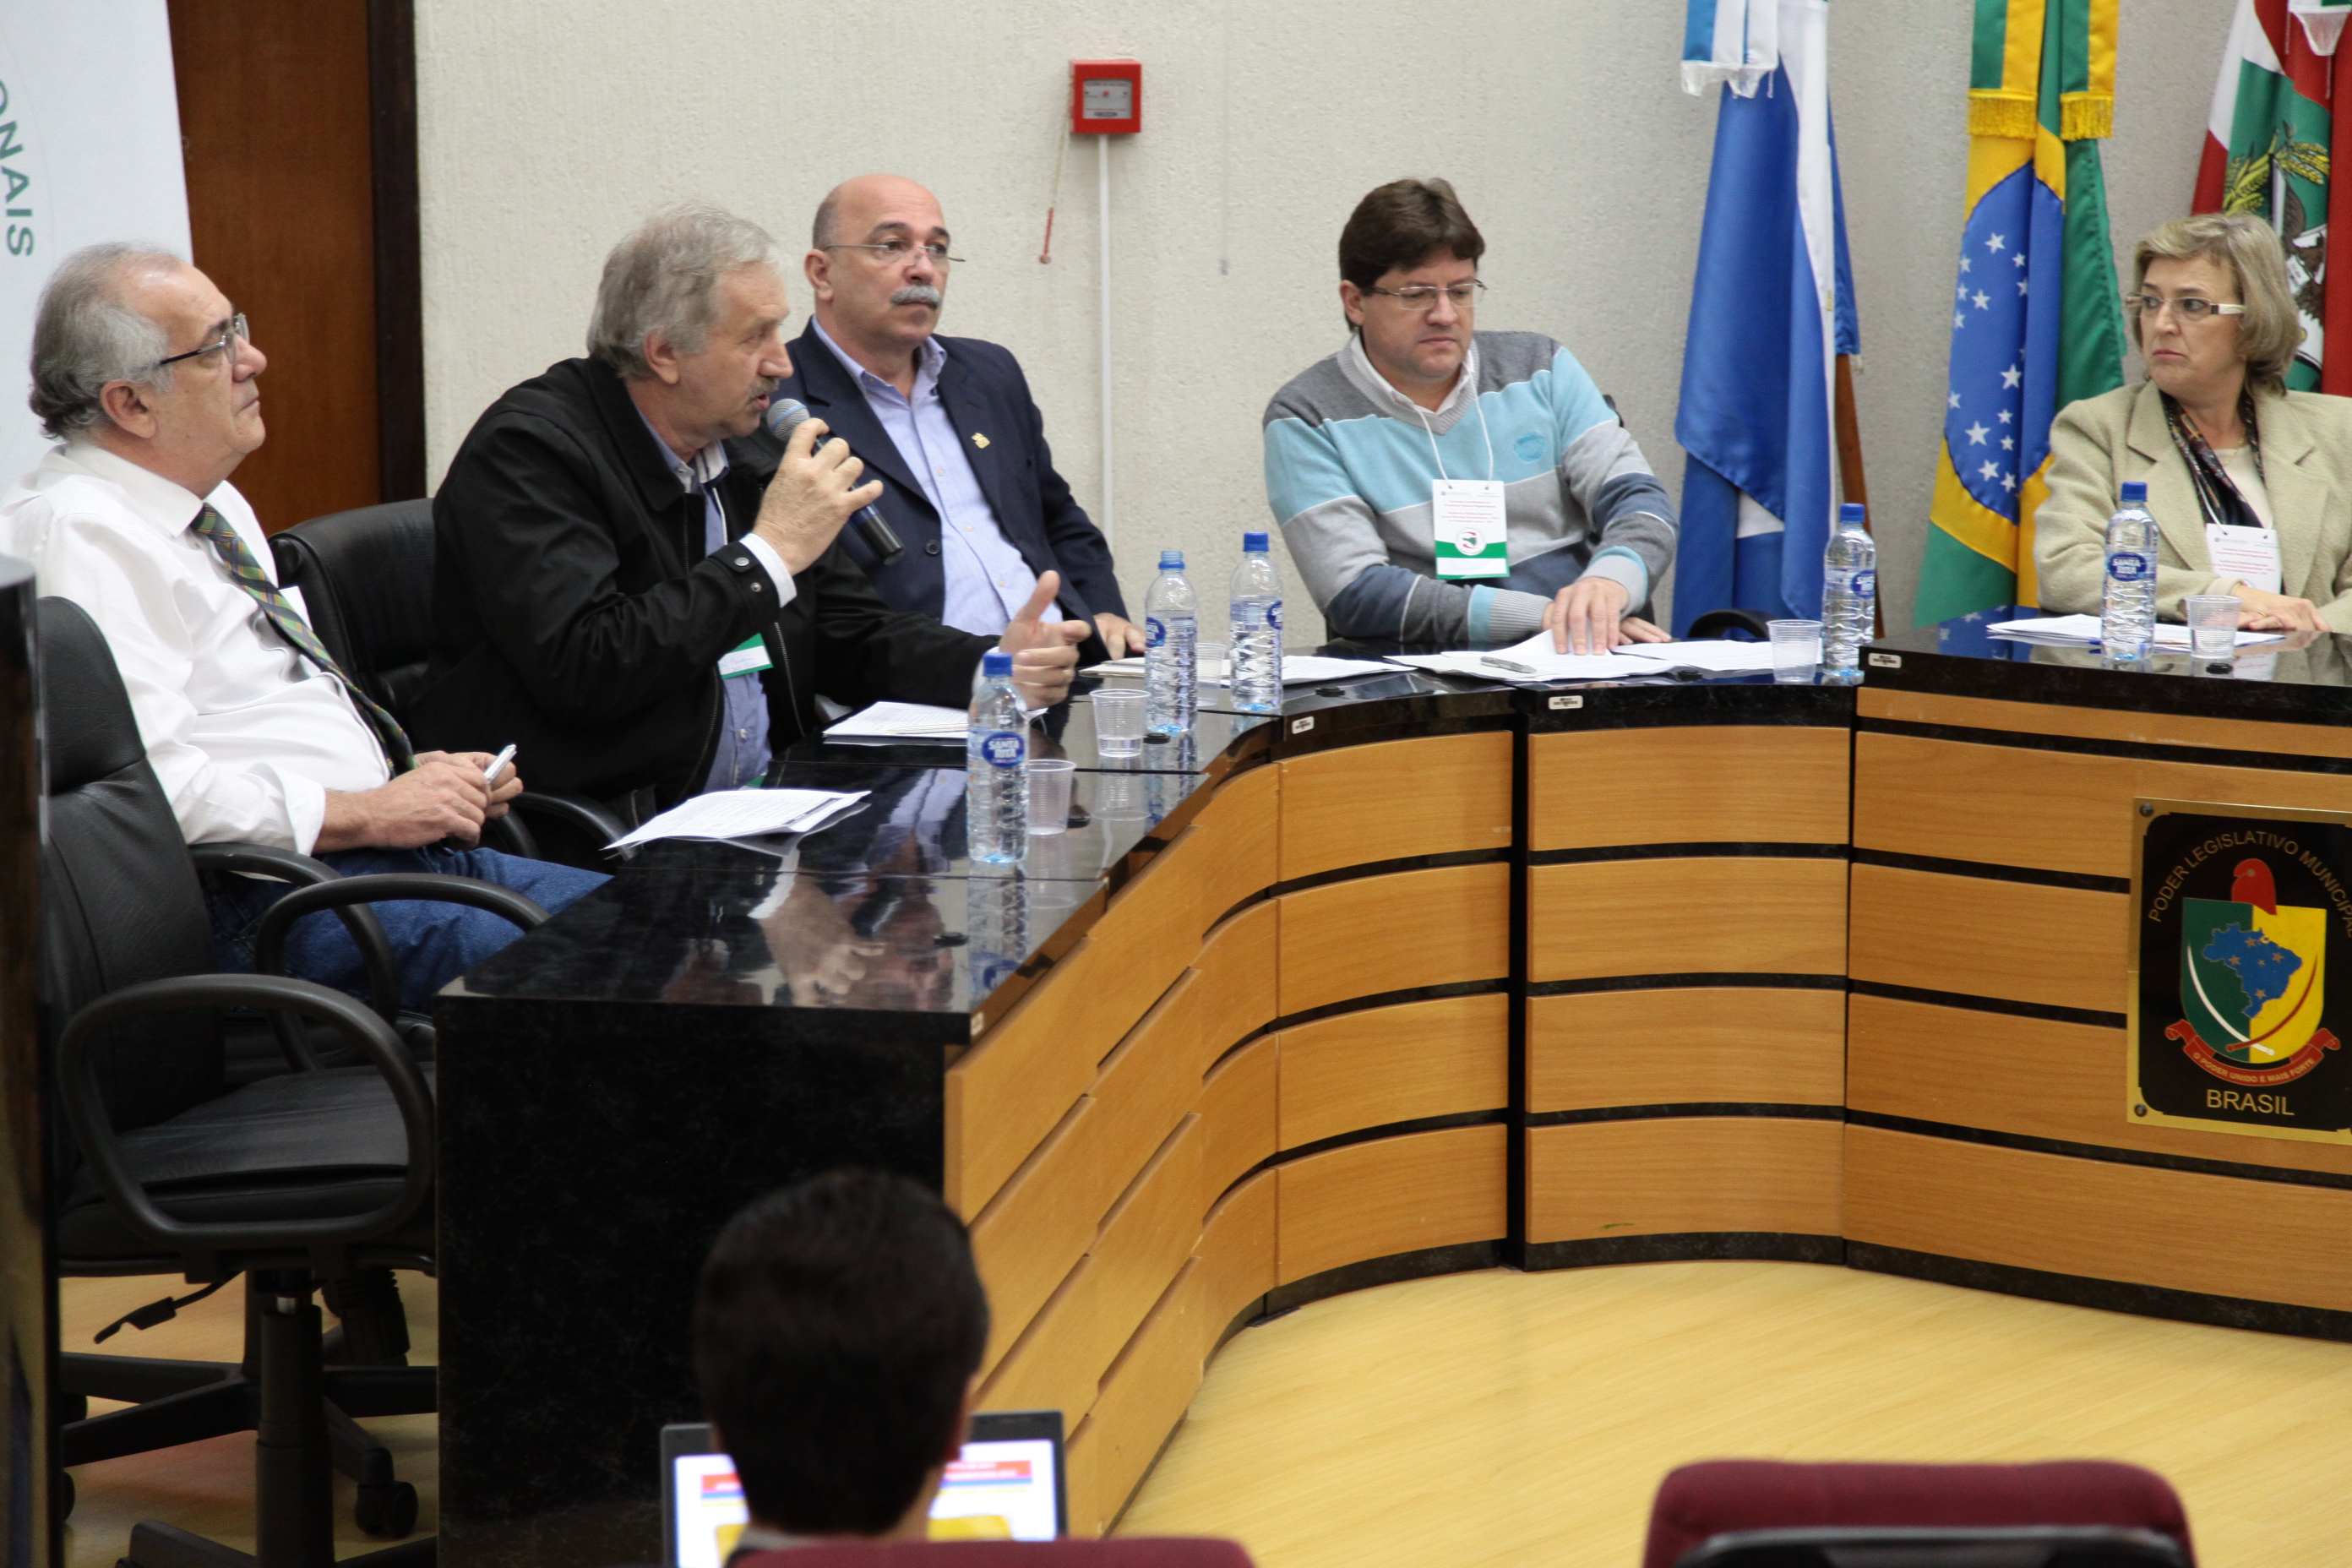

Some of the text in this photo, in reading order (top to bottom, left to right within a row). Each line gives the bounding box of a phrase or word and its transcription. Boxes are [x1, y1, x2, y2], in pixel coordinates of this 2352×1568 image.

[988, 740, 1020, 750] SANTA
[994, 749, 1017, 759] RITA
[2148, 865, 2190, 923] PODER
[2183, 830, 2299, 868] LEGISLATIVO
[2200, 1059, 2229, 1076] PODER
[2230, 1072, 2258, 1082] UNIDO
[2268, 1072, 2289, 1082] MAIS
[2289, 1058, 2316, 1076] FORTE
[2206, 1088, 2295, 1116] BRASIL
